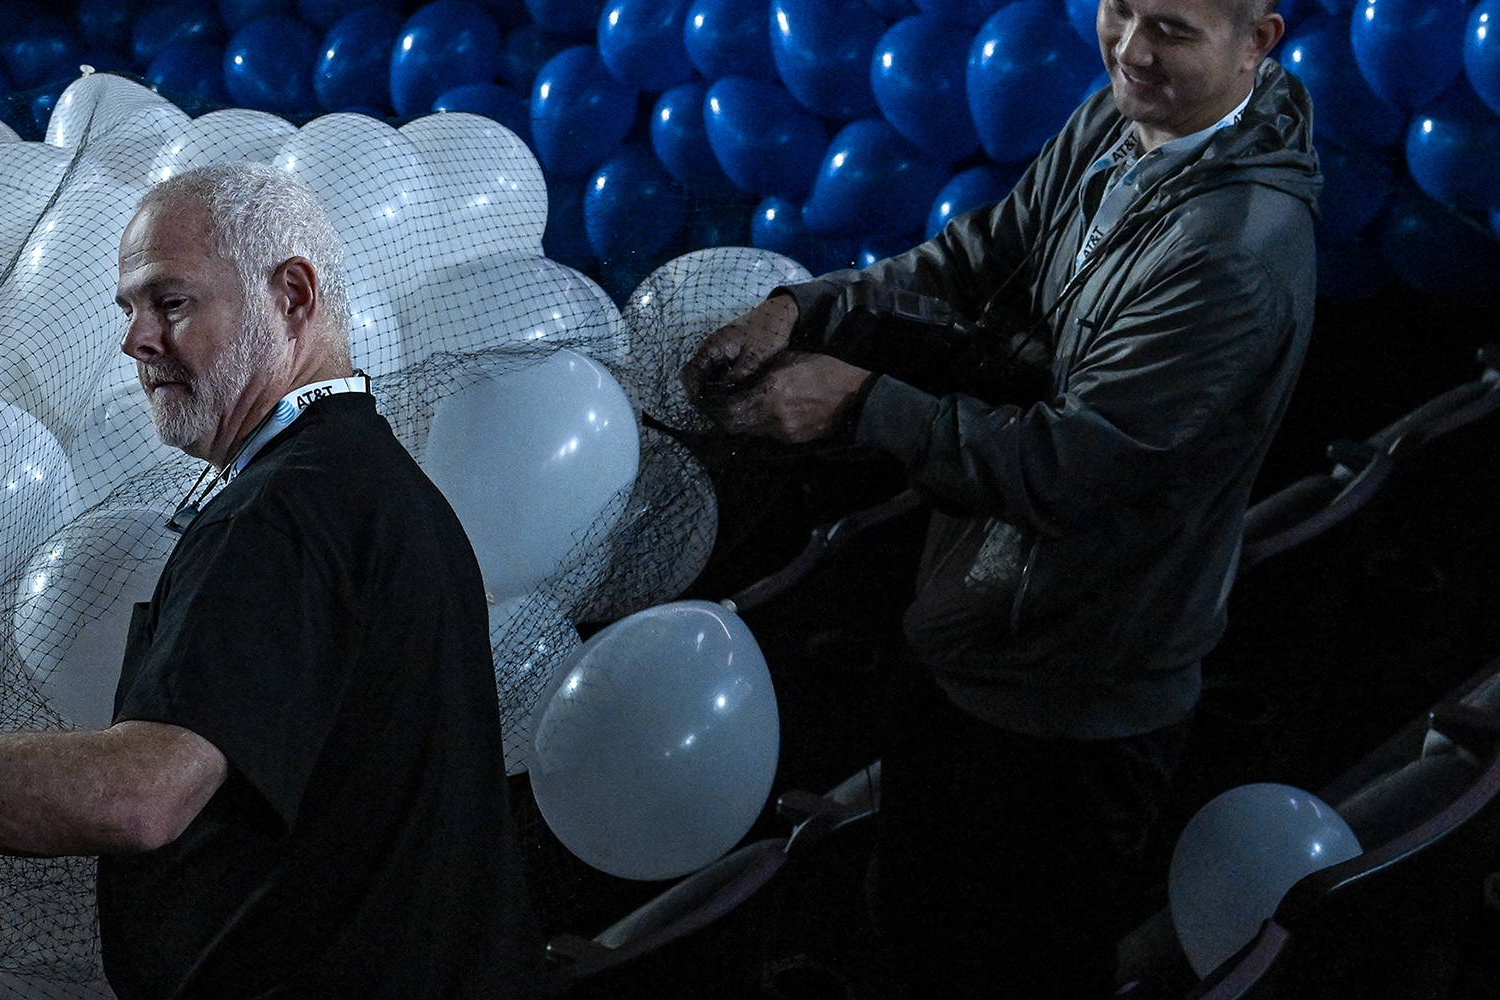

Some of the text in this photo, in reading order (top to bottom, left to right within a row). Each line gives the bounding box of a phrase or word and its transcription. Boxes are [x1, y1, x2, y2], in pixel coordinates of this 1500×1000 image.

[1111, 132, 1139, 163] AT&T
[1083, 224, 1106, 257] AT&T
[296, 385, 333, 410] AT&T
